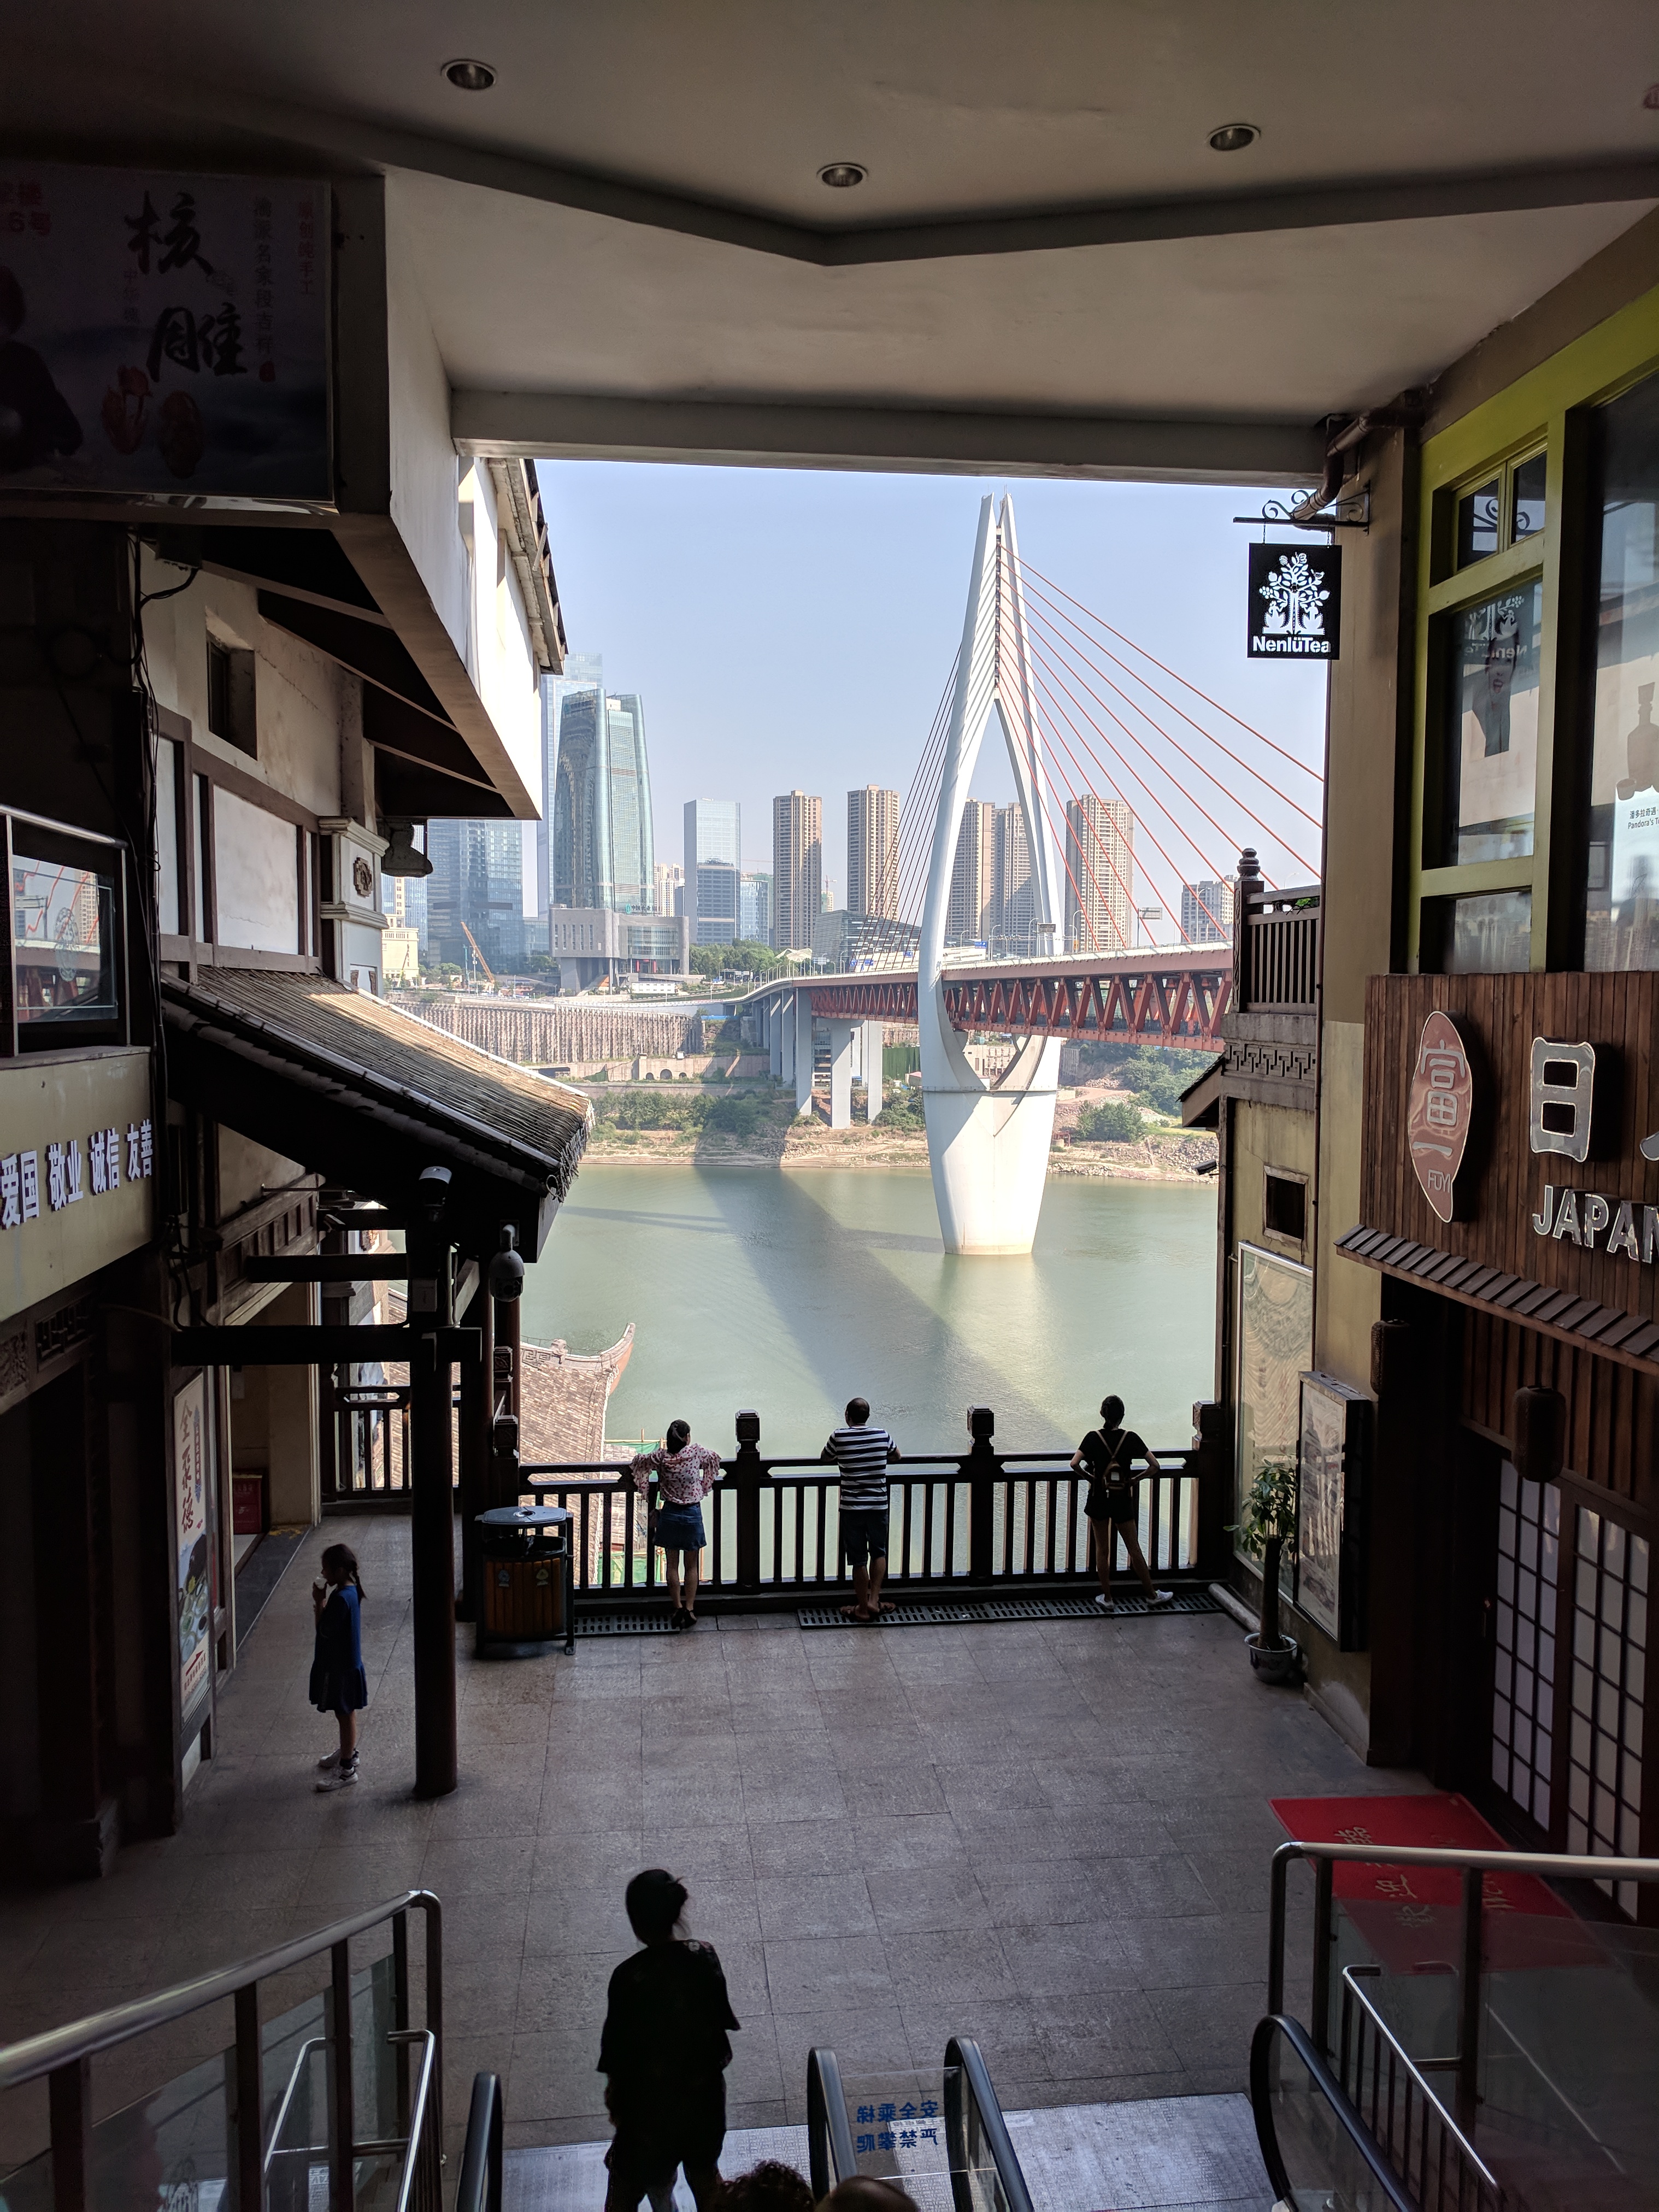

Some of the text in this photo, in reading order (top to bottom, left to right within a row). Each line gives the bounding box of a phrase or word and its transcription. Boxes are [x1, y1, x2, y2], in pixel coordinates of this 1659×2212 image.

[1253, 636, 1332, 653] NenlüTea
[1628, 818, 1654, 829] Pandora's
[1, 1119, 153, 1229] 爱国 敬业 诚信 友善
[1427, 1169, 1451, 1193] FUYI
